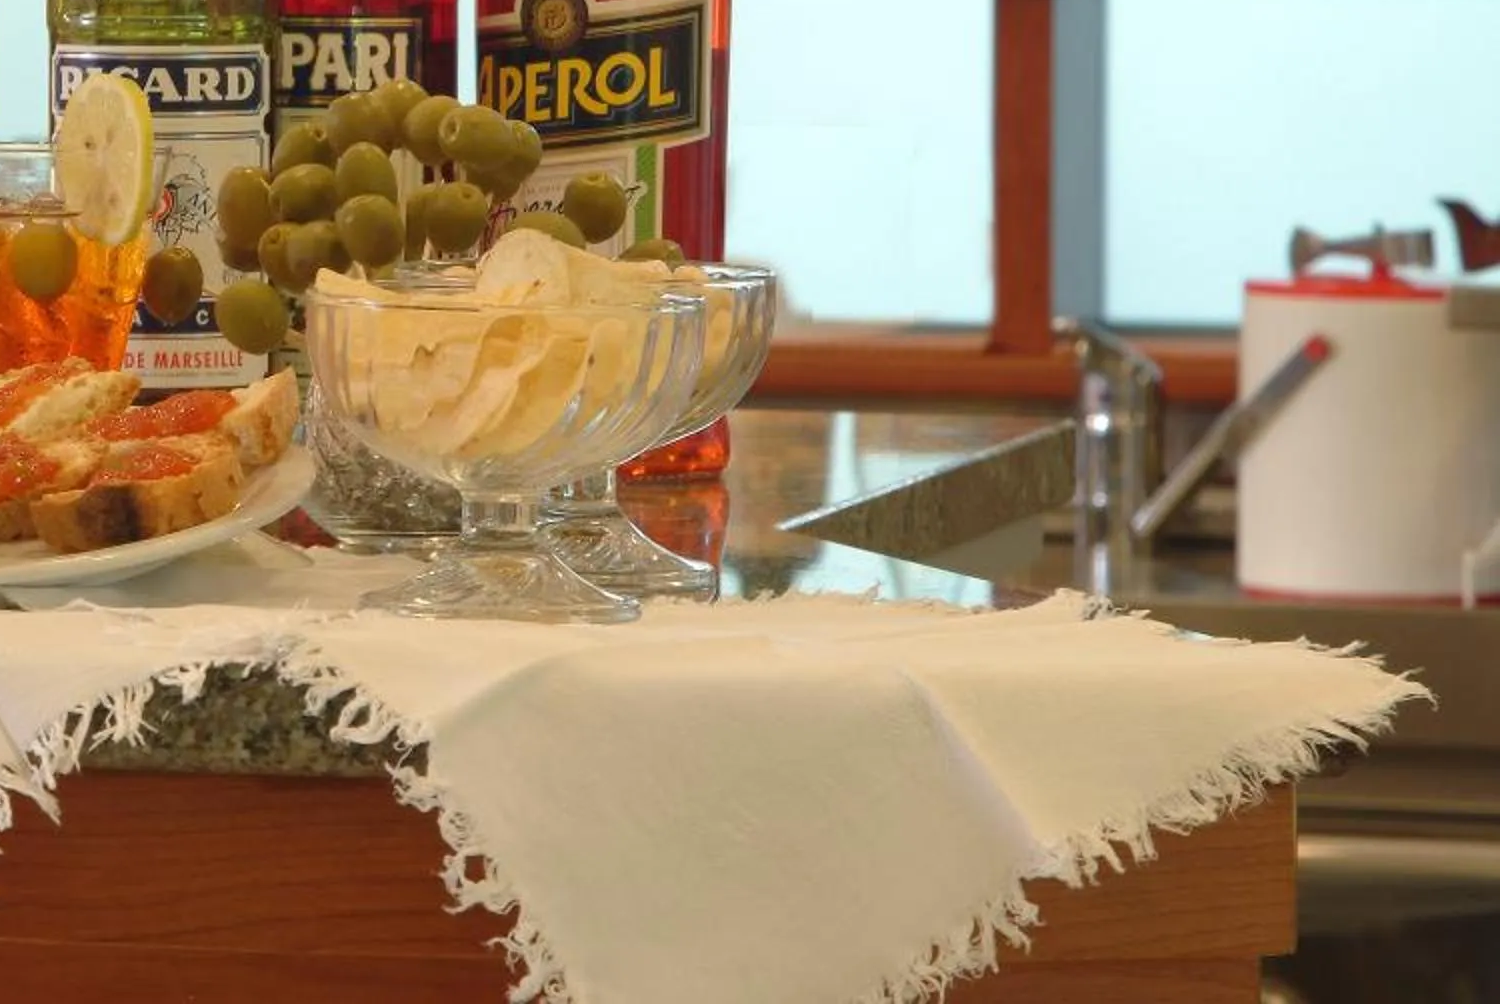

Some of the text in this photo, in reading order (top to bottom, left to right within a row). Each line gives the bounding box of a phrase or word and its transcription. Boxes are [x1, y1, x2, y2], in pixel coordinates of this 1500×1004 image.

[60, 66, 256, 101] RARD
[480, 47, 676, 122] APEROL
[123, 349, 244, 370] DE MARSEILLE
